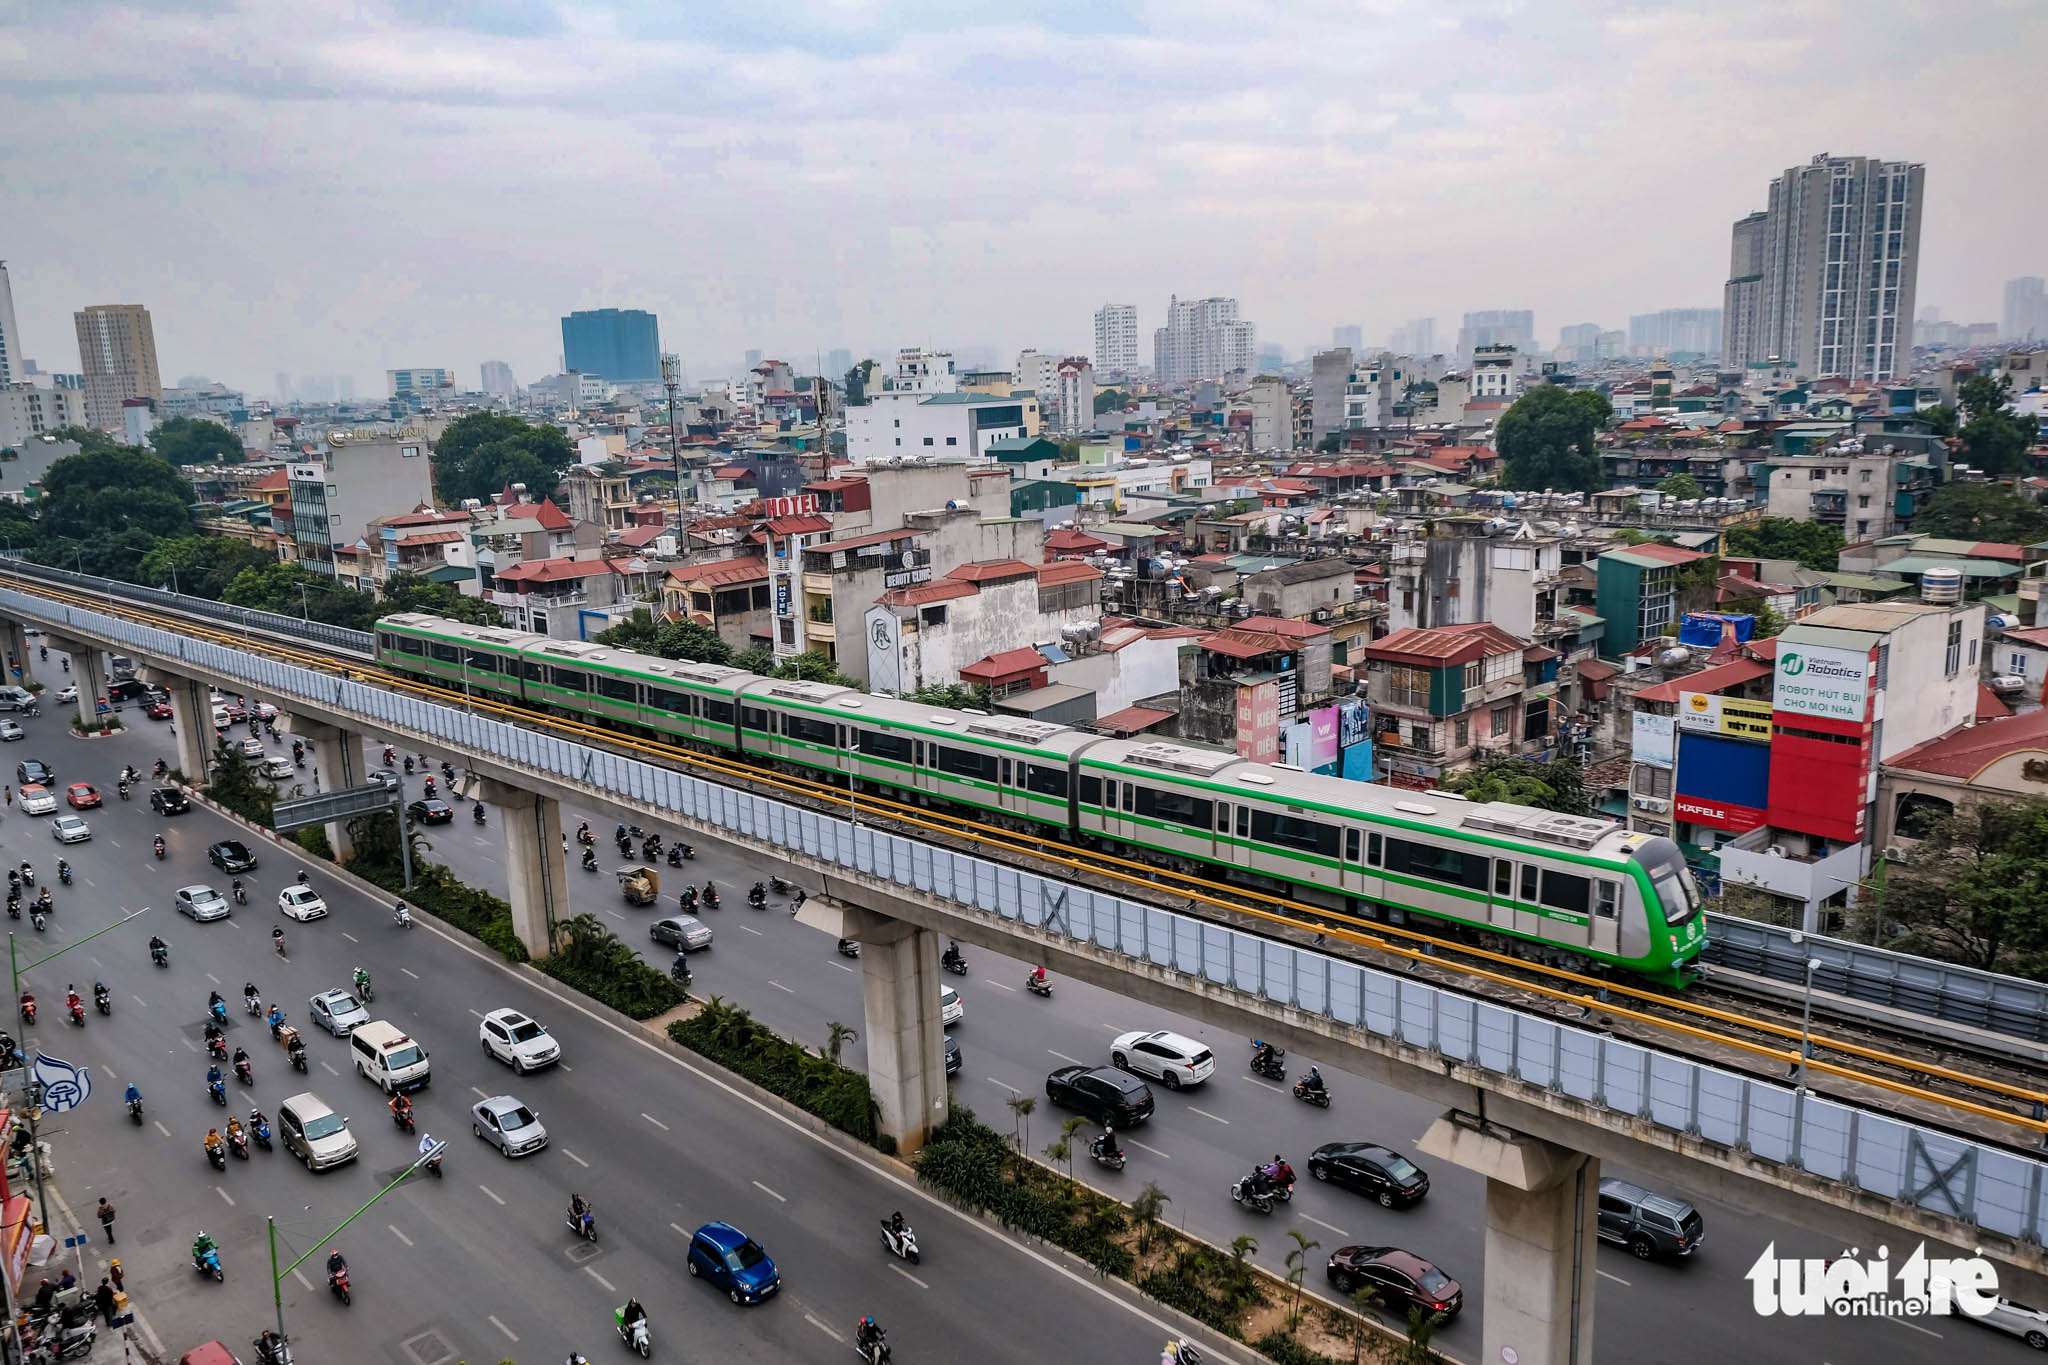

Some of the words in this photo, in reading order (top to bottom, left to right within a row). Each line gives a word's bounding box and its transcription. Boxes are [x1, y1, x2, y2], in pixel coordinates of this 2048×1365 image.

[767, 494, 821, 517] HOTEL
[886, 573, 911, 588] BEAUTY
[912, 568, 931, 583] CLINIC
[778, 586, 787, 615] HOTEL
[1808, 657, 1842, 667] Vietnam
[1807, 664, 1862, 678] Robotics
[1779, 684, 1815, 696] ROBOT
[1784, 698, 1807, 709] CHO
